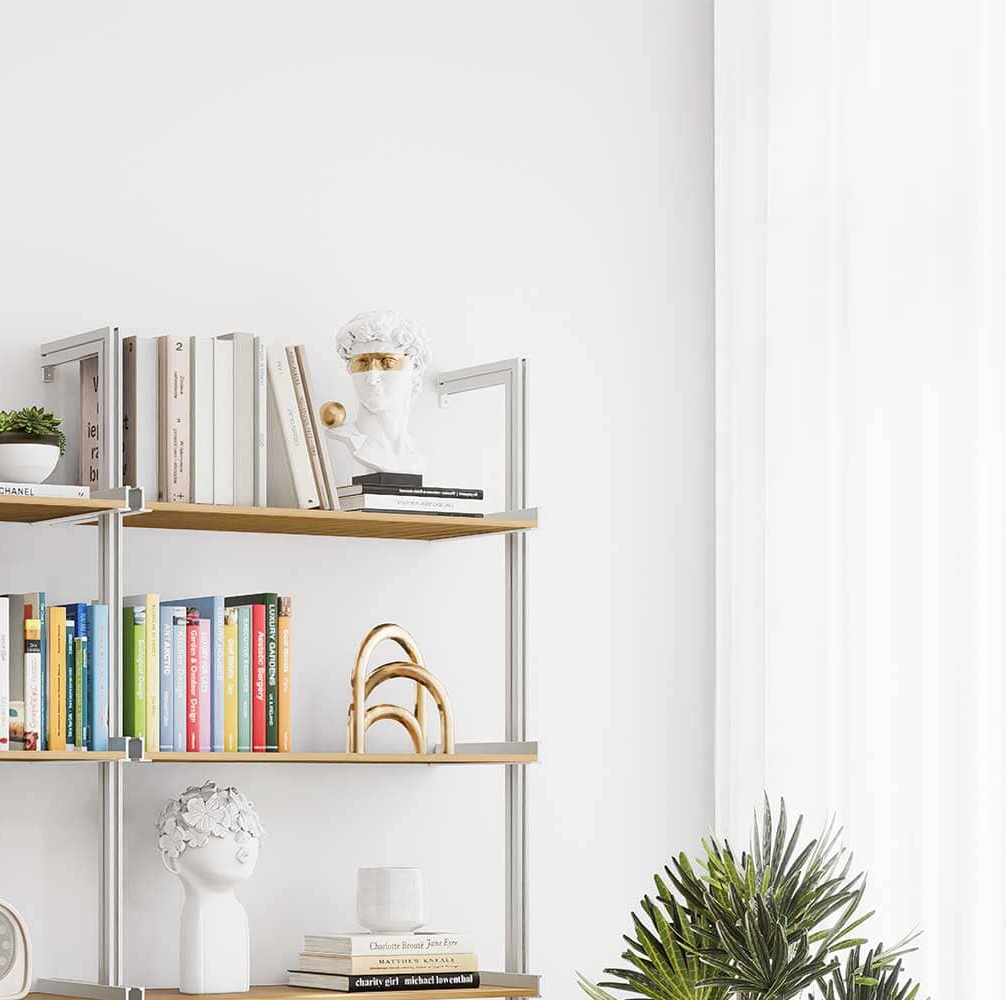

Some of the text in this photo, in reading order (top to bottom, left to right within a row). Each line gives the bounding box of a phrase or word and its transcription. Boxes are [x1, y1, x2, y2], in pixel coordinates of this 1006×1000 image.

[176, 342, 183, 351] 2
[257, 667, 265, 701] Surgery
[189, 698, 198, 723] Design
[369, 940, 400, 950] Charlotte
[425, 937, 441, 950] Jane
[443, 939, 458, 949] Eyre
[355, 973, 473, 988] charity girl michael lowenthal
